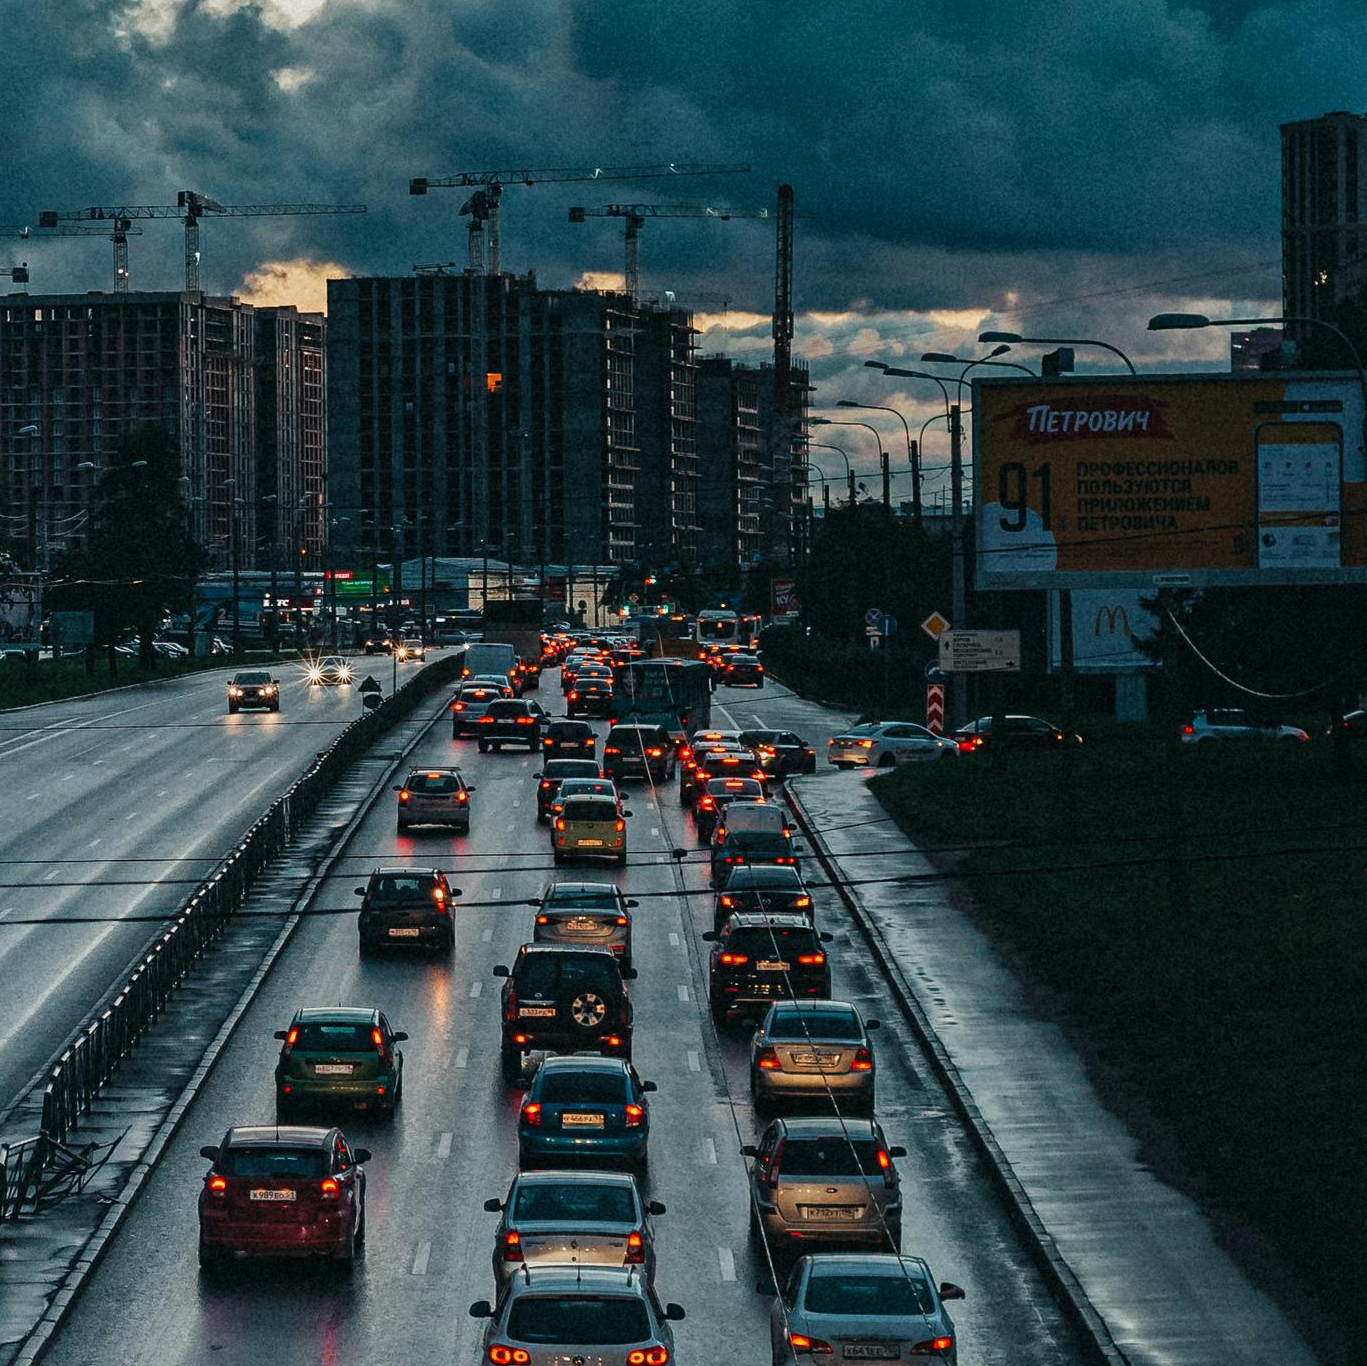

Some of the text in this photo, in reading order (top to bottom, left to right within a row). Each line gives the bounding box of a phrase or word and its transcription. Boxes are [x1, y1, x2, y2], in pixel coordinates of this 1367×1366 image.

[1076, 460, 1240, 476] ПРОФЕССИОНАЛОВ
[1076, 478, 1192, 494] ПОЛЬЗУЮТСЯ
[1076, 496, 1210, 512] ПРИЛОЖЕНИЕМ
[1076, 515, 1178, 532] ПЕТРОВИЧА
